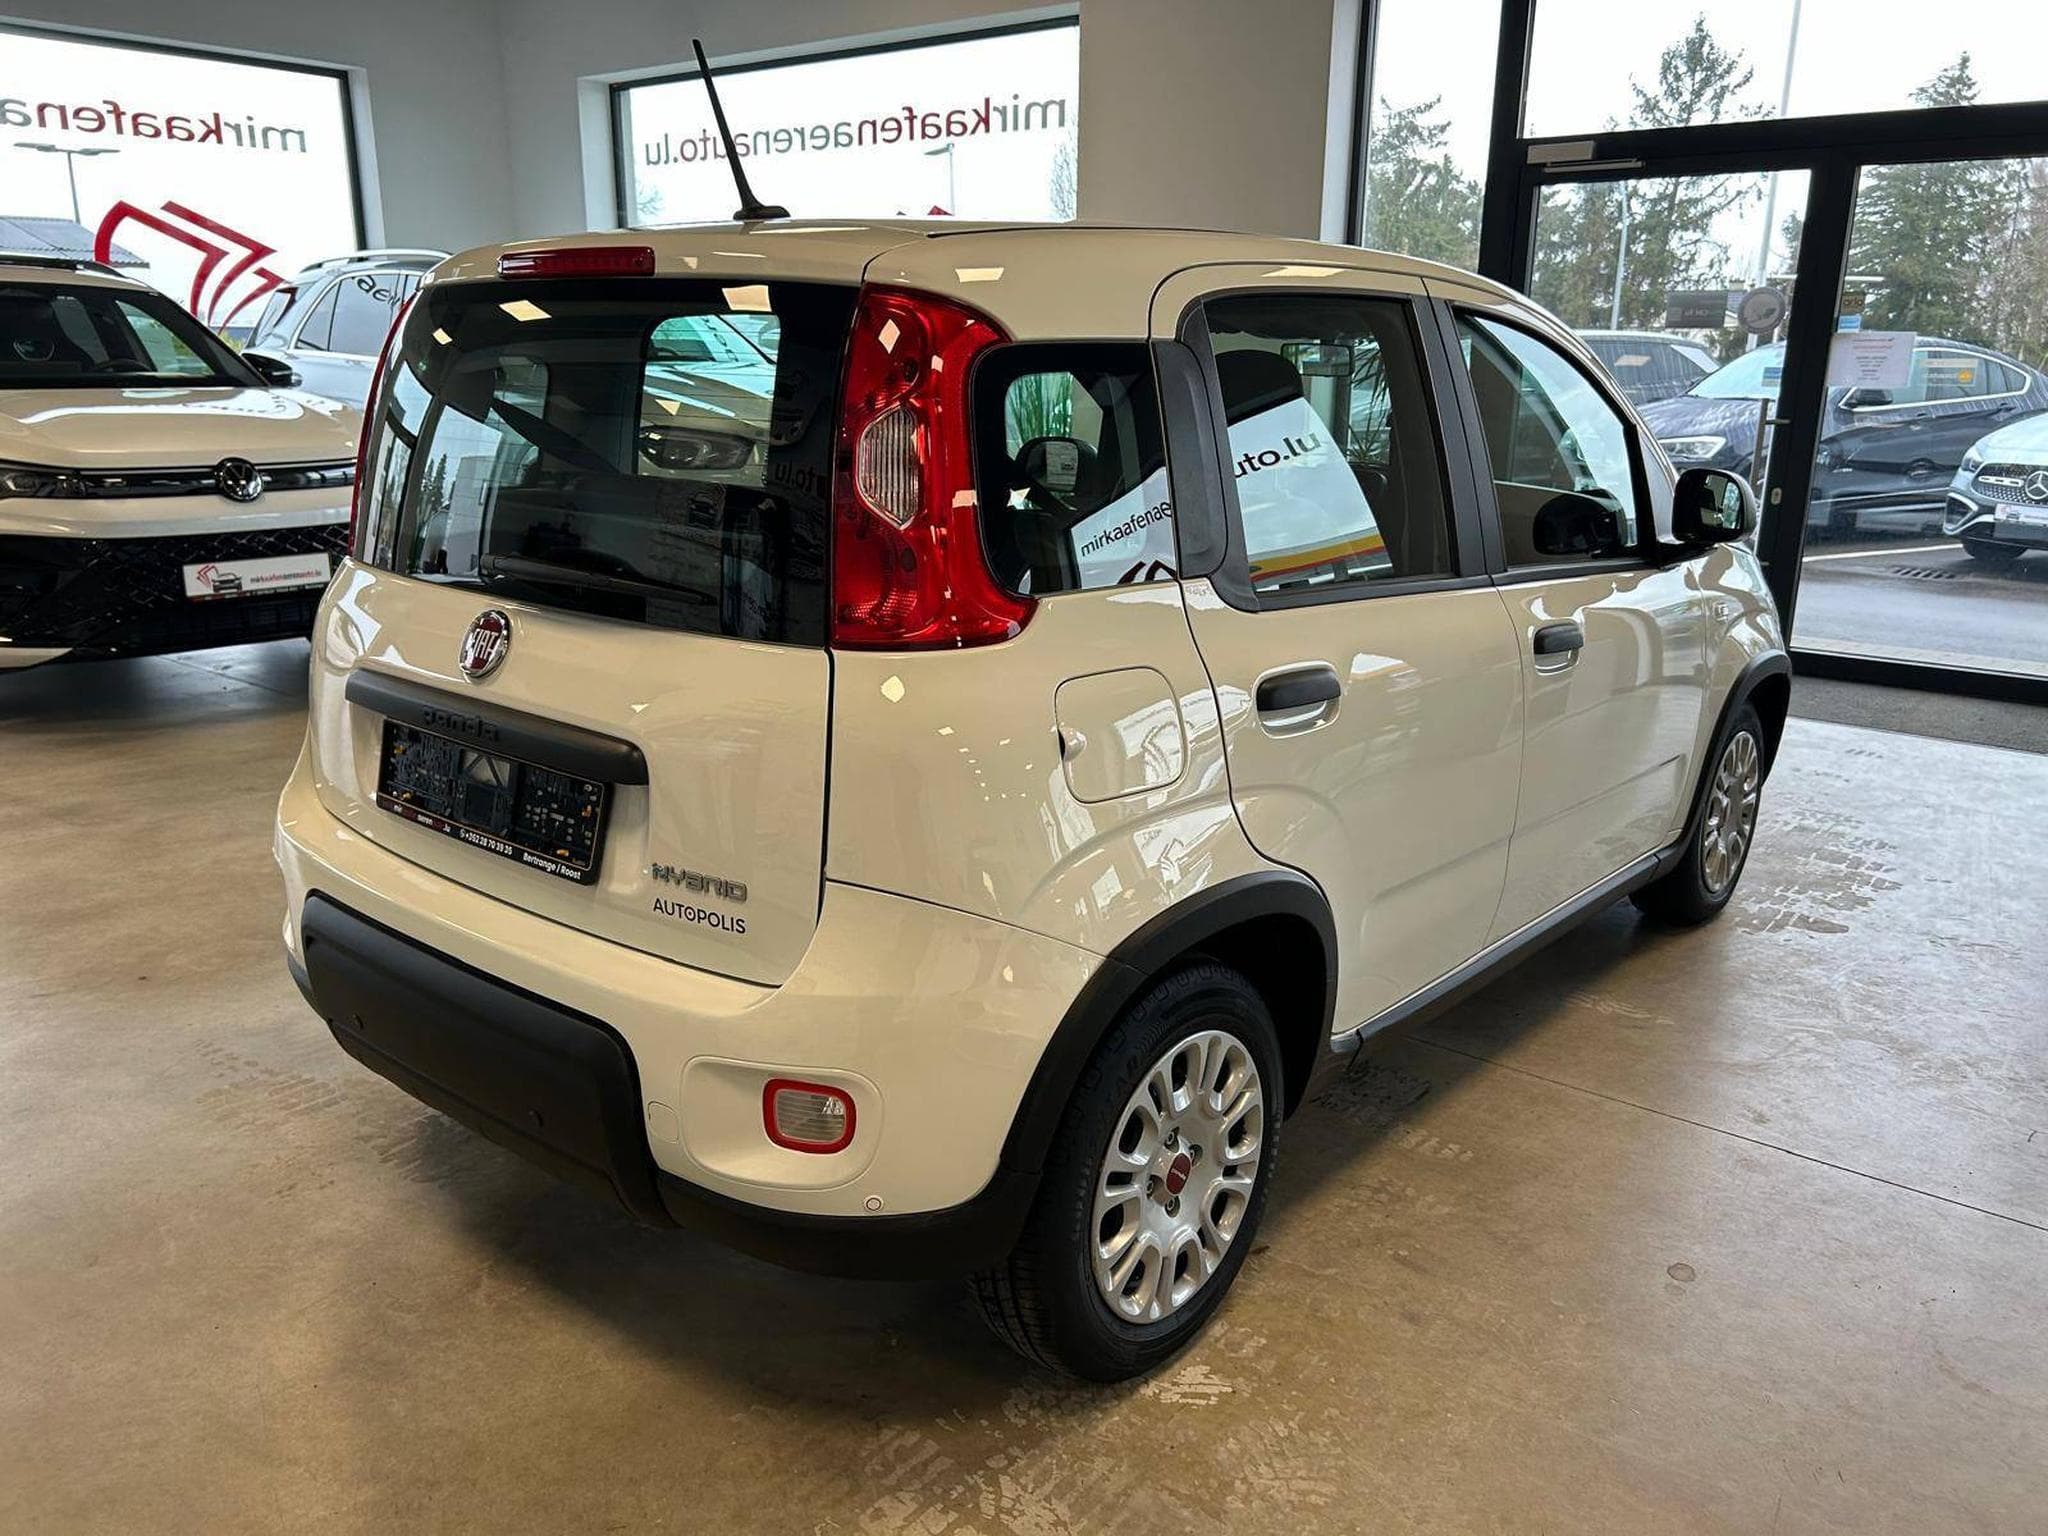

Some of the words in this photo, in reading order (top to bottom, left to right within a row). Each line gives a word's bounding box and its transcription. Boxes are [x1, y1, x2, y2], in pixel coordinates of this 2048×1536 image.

[470, 628, 499, 660] FIAT
[652, 863, 748, 904] HYBRID
[653, 898, 746, 934] AUTOPOLIS
